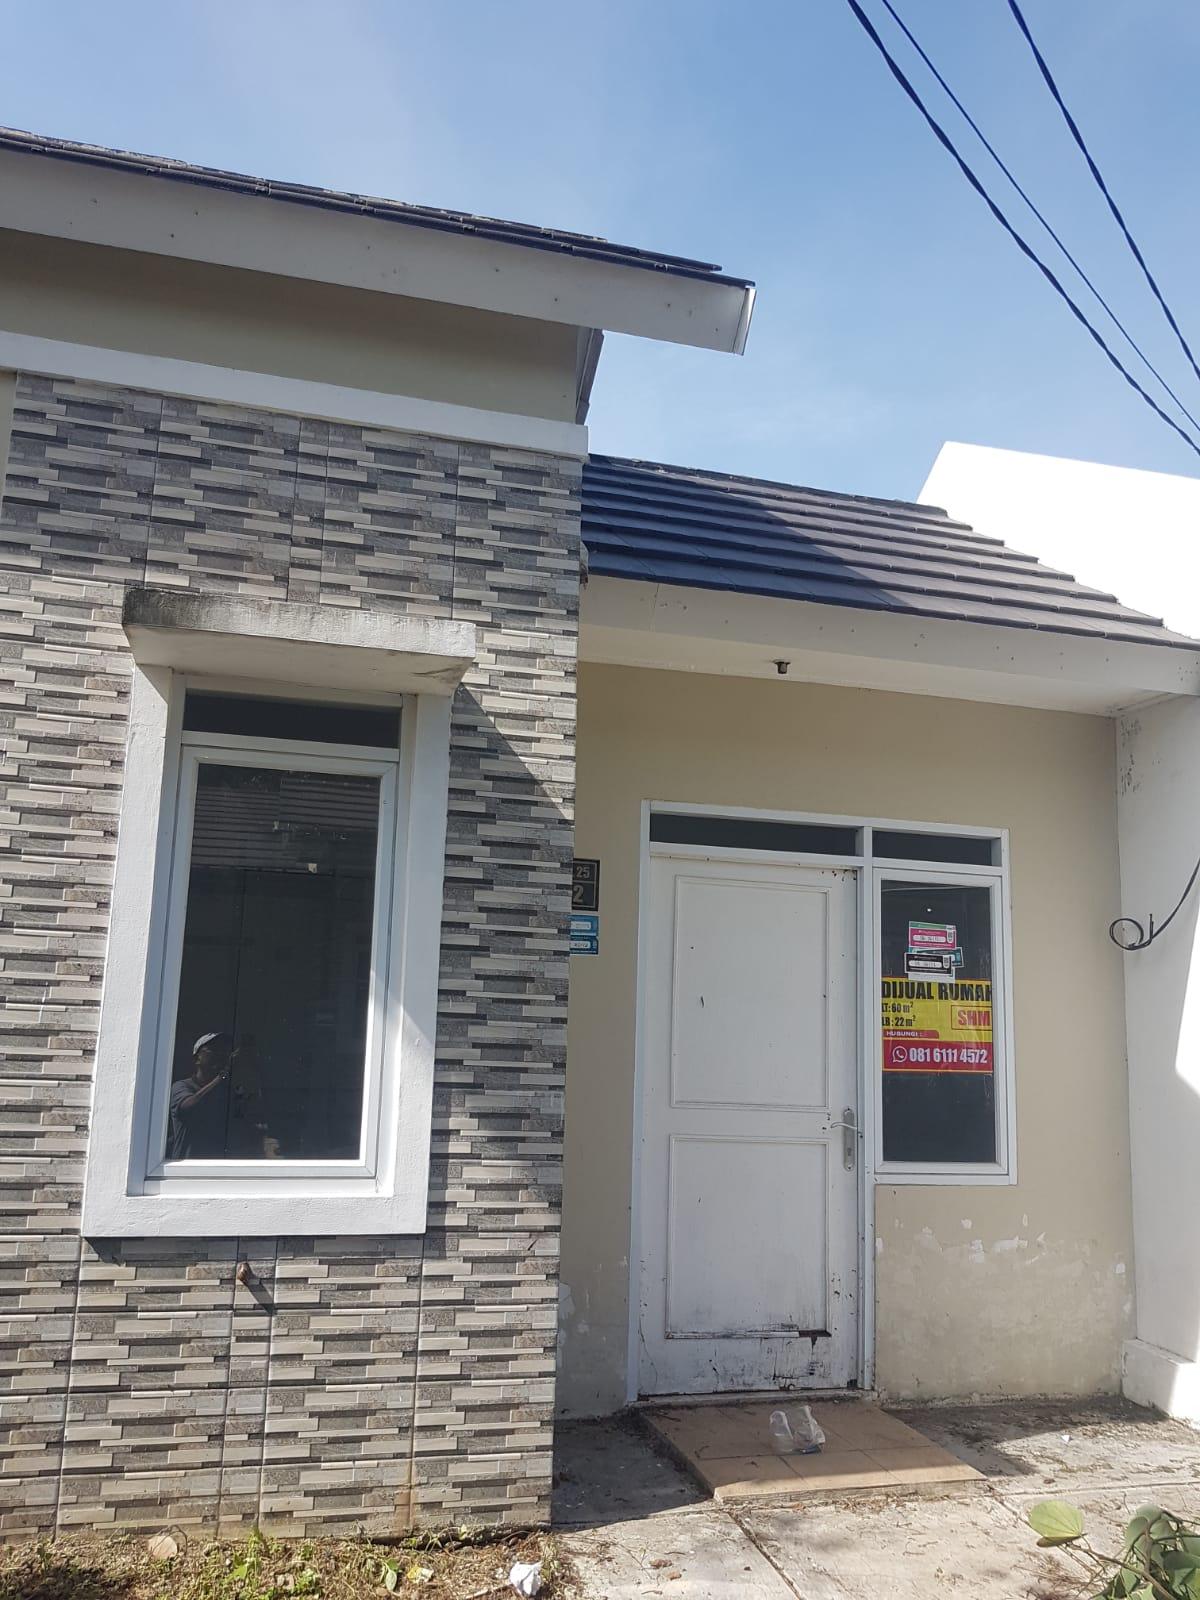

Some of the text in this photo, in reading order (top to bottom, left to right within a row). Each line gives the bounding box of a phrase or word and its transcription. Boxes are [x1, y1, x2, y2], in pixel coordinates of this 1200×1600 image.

[576, 865, 590, 879] 25
[882, 981, 934, 999] DIJUAL
[957, 1010, 991, 1026] SHM
[909, 1047, 987, 1064] 081 6111 4572
